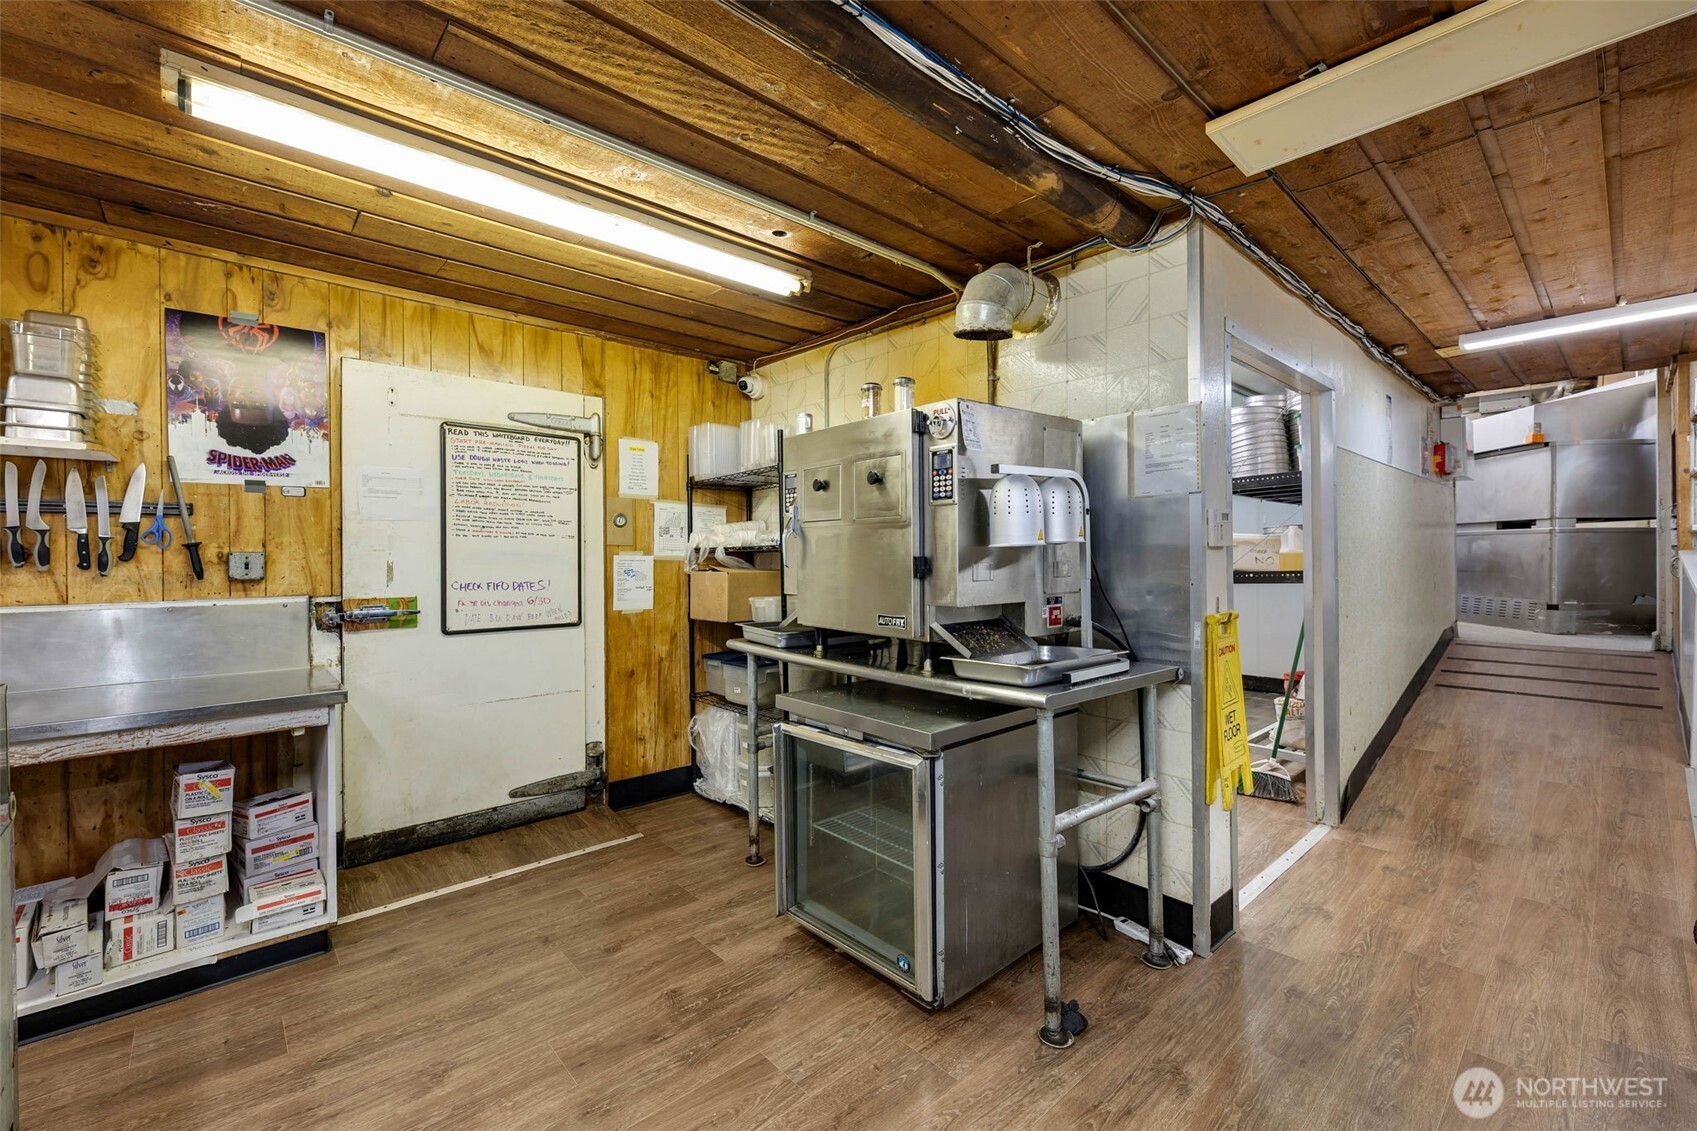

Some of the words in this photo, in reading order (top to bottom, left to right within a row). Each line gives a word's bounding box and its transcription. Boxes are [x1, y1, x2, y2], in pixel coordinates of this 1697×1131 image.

[933, 408, 948, 416] PULL
[492, 433, 530, 442] WHITEBOARD
[451, 581, 483, 591] CHECK
[486, 581, 509, 591] FIFO
[512, 580, 550, 591] DATES!
[527, 596, 551, 607] 6/30
[878, 617, 905, 626] AUTOFRY
[1218, 644, 1236, 656] CAUTION
[1225, 710, 1236, 726] WET
[1224, 723, 1241, 744] FLOOR
[188, 858, 210, 867] Sysco
